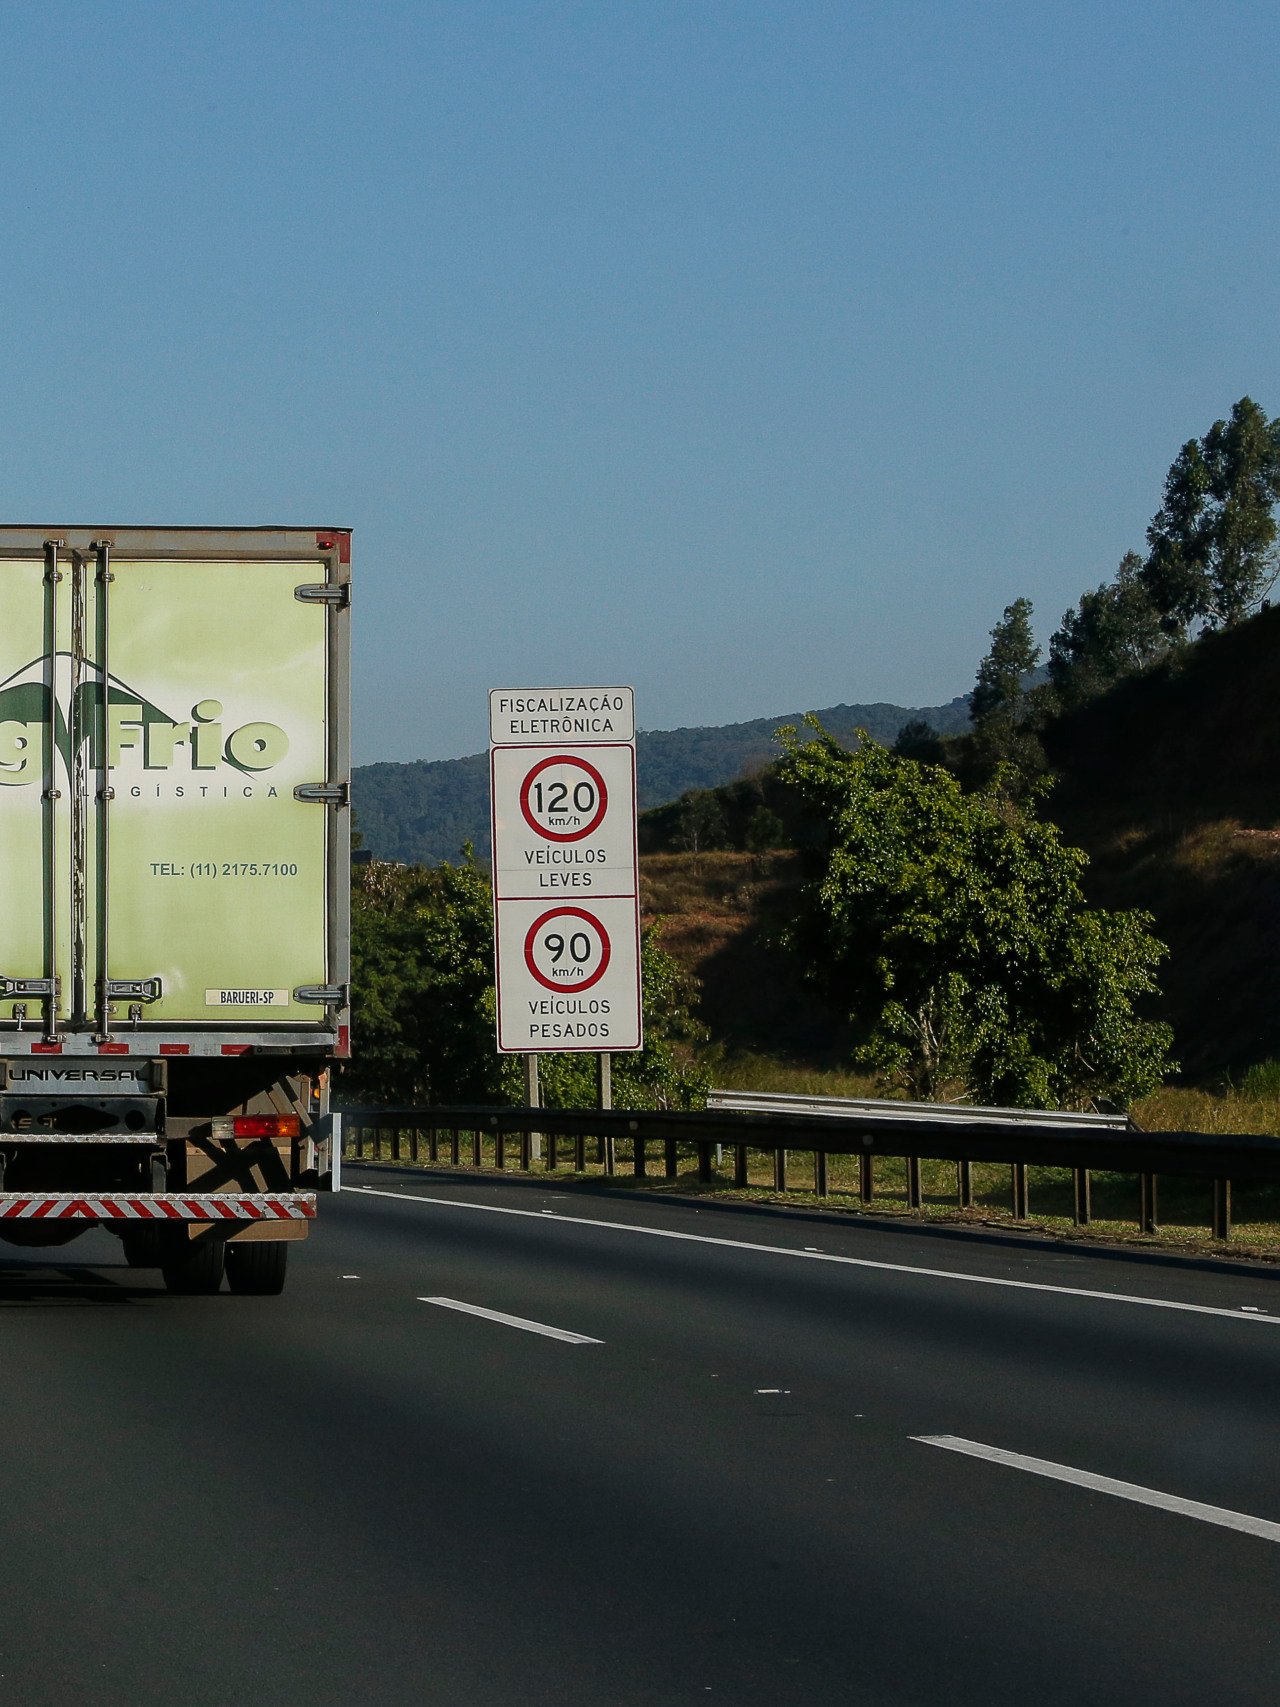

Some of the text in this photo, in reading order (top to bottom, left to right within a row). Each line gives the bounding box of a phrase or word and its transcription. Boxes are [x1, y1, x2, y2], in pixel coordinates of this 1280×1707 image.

[510, 716, 613, 733] ELETRÔNICA
[534, 781, 595, 813] 120
[548, 816, 581, 826] km/h
[524, 845, 606, 864] VEÍCULOS
[150, 863, 298, 878] TEL: (11) 2175.7100
[539, 873, 593, 887] LEVES
[544, 932, 591, 963] 90
[551, 967, 584, 977] km/h
[220, 991, 274, 1004] BARUERI-SP
[528, 996, 611, 1014] VEÍCULOS
[529, 1023, 609, 1038] PESADOS
[8, 1069, 148, 1081] UNIVERSAL
